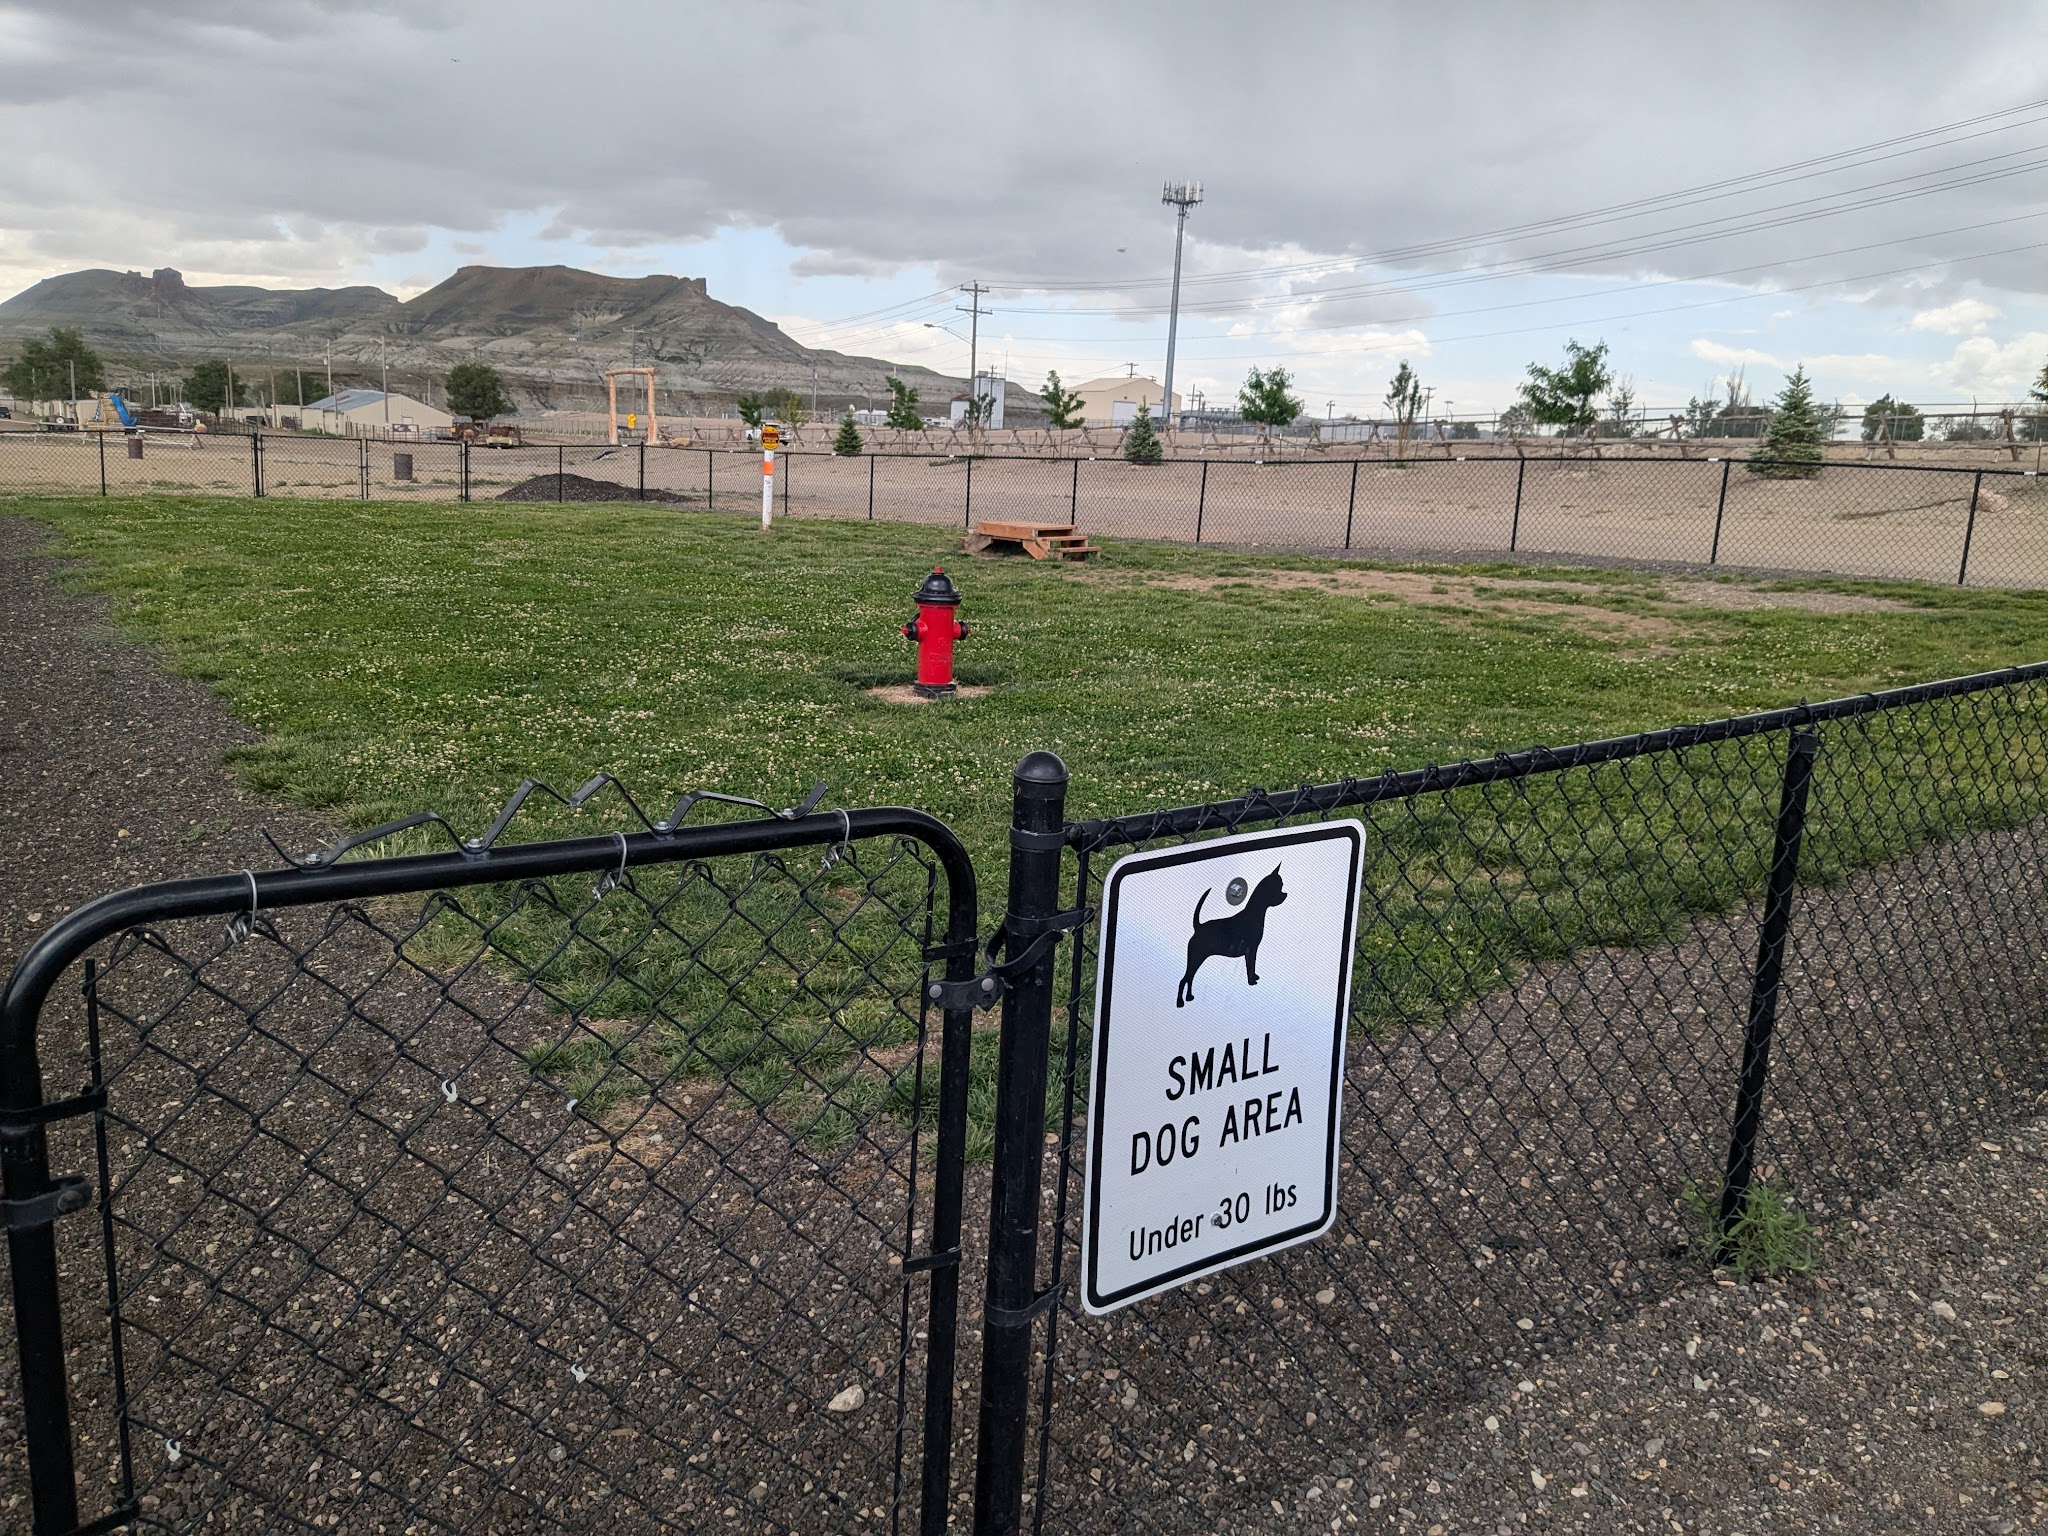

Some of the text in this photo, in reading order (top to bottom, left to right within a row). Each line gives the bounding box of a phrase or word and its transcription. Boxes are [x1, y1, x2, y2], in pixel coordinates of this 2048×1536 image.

[1165, 1033, 1279, 1101] SMALL
[1131, 1086, 1303, 1176] DOG AREA
[1129, 1183, 1297, 1261] Under 30 lbs
